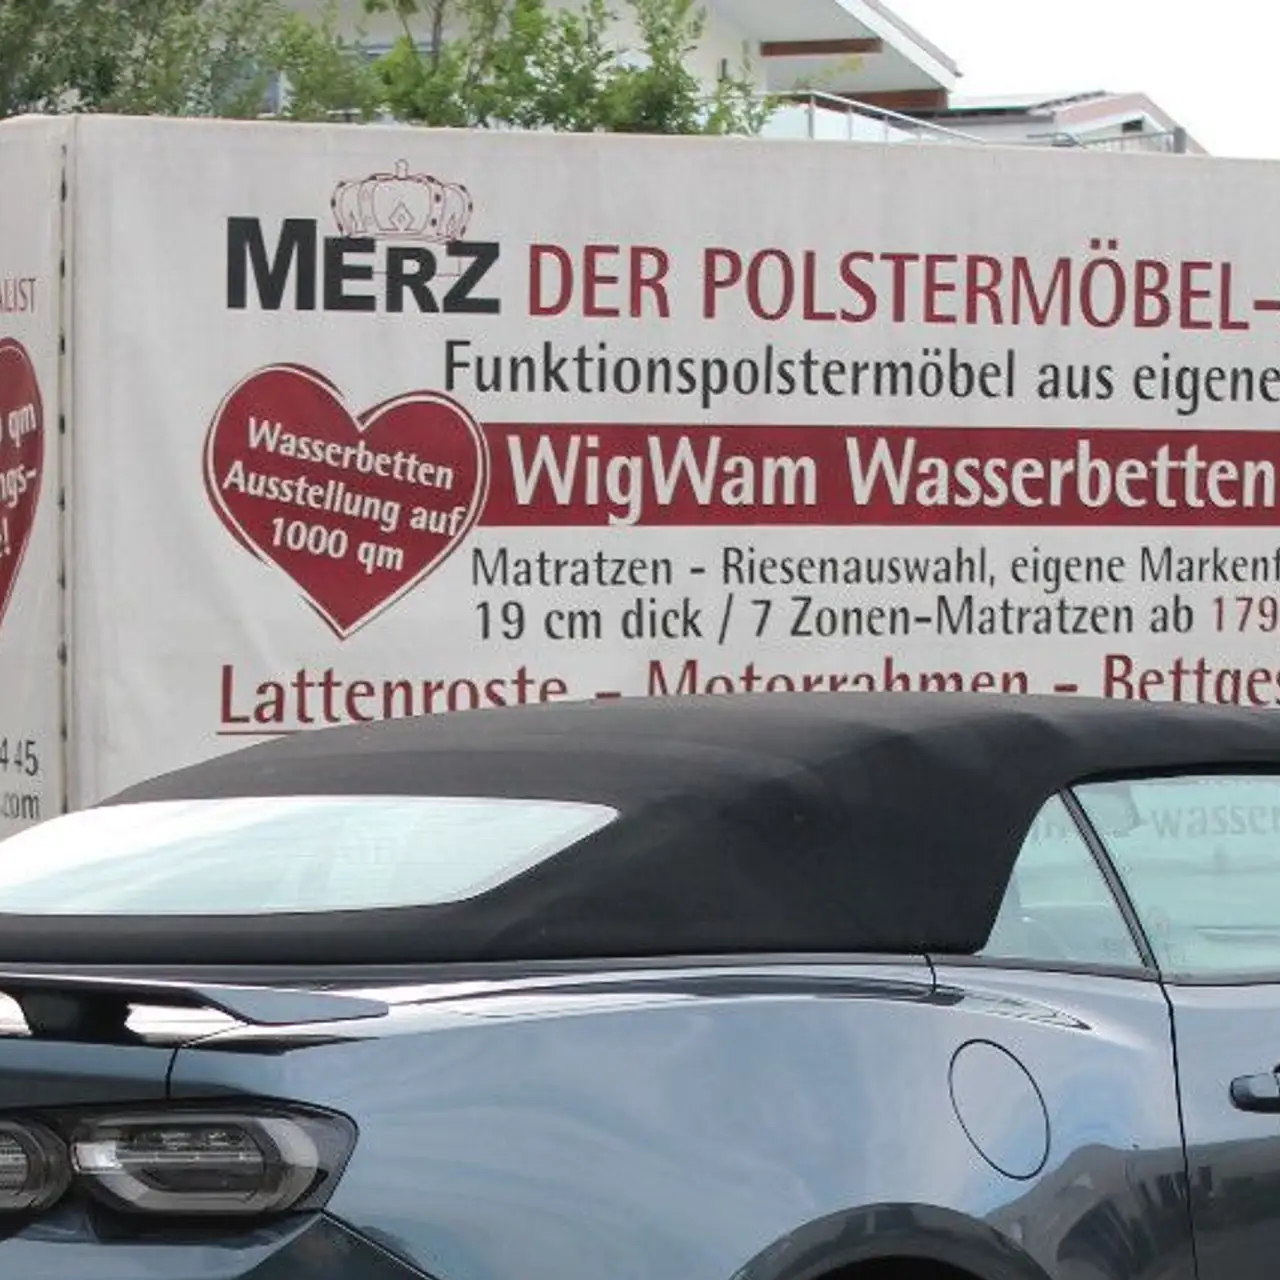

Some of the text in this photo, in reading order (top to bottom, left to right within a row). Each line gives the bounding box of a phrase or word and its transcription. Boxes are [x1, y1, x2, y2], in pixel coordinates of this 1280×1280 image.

[226, 217, 501, 314] MERZ
[529, 244, 670, 318] DER
[445, 339, 1014, 409] Funktionspolstermöbel
[1038, 363, 1114, 400] aus
[8, 402, 36, 447] qm
[248, 417, 453, 490] Wasserbetten
[223, 459, 468, 537] Ausstellung auf
[507, 435, 817, 525] WigWam
[846, 436, 1276, 508] Wasserbetten
[271, 516, 404, 575] 1000 qm
[472, 547, 672, 586] Matratzen
[723, 546, 996, 588] Riesenauswahl,
[1011, 546, 1125, 594] eigene
[476, 600, 525, 640] 19
[545, 609, 602, 640] cm
[621, 597, 703, 639] dick
[718, 592, 733, 645] /
[751, 599, 772, 637] 7
[790, 594, 1133, 637] Zonen-Matratzen
[1150, 595, 1194, 634] ab
[221, 664, 568, 724] Lattenroste
